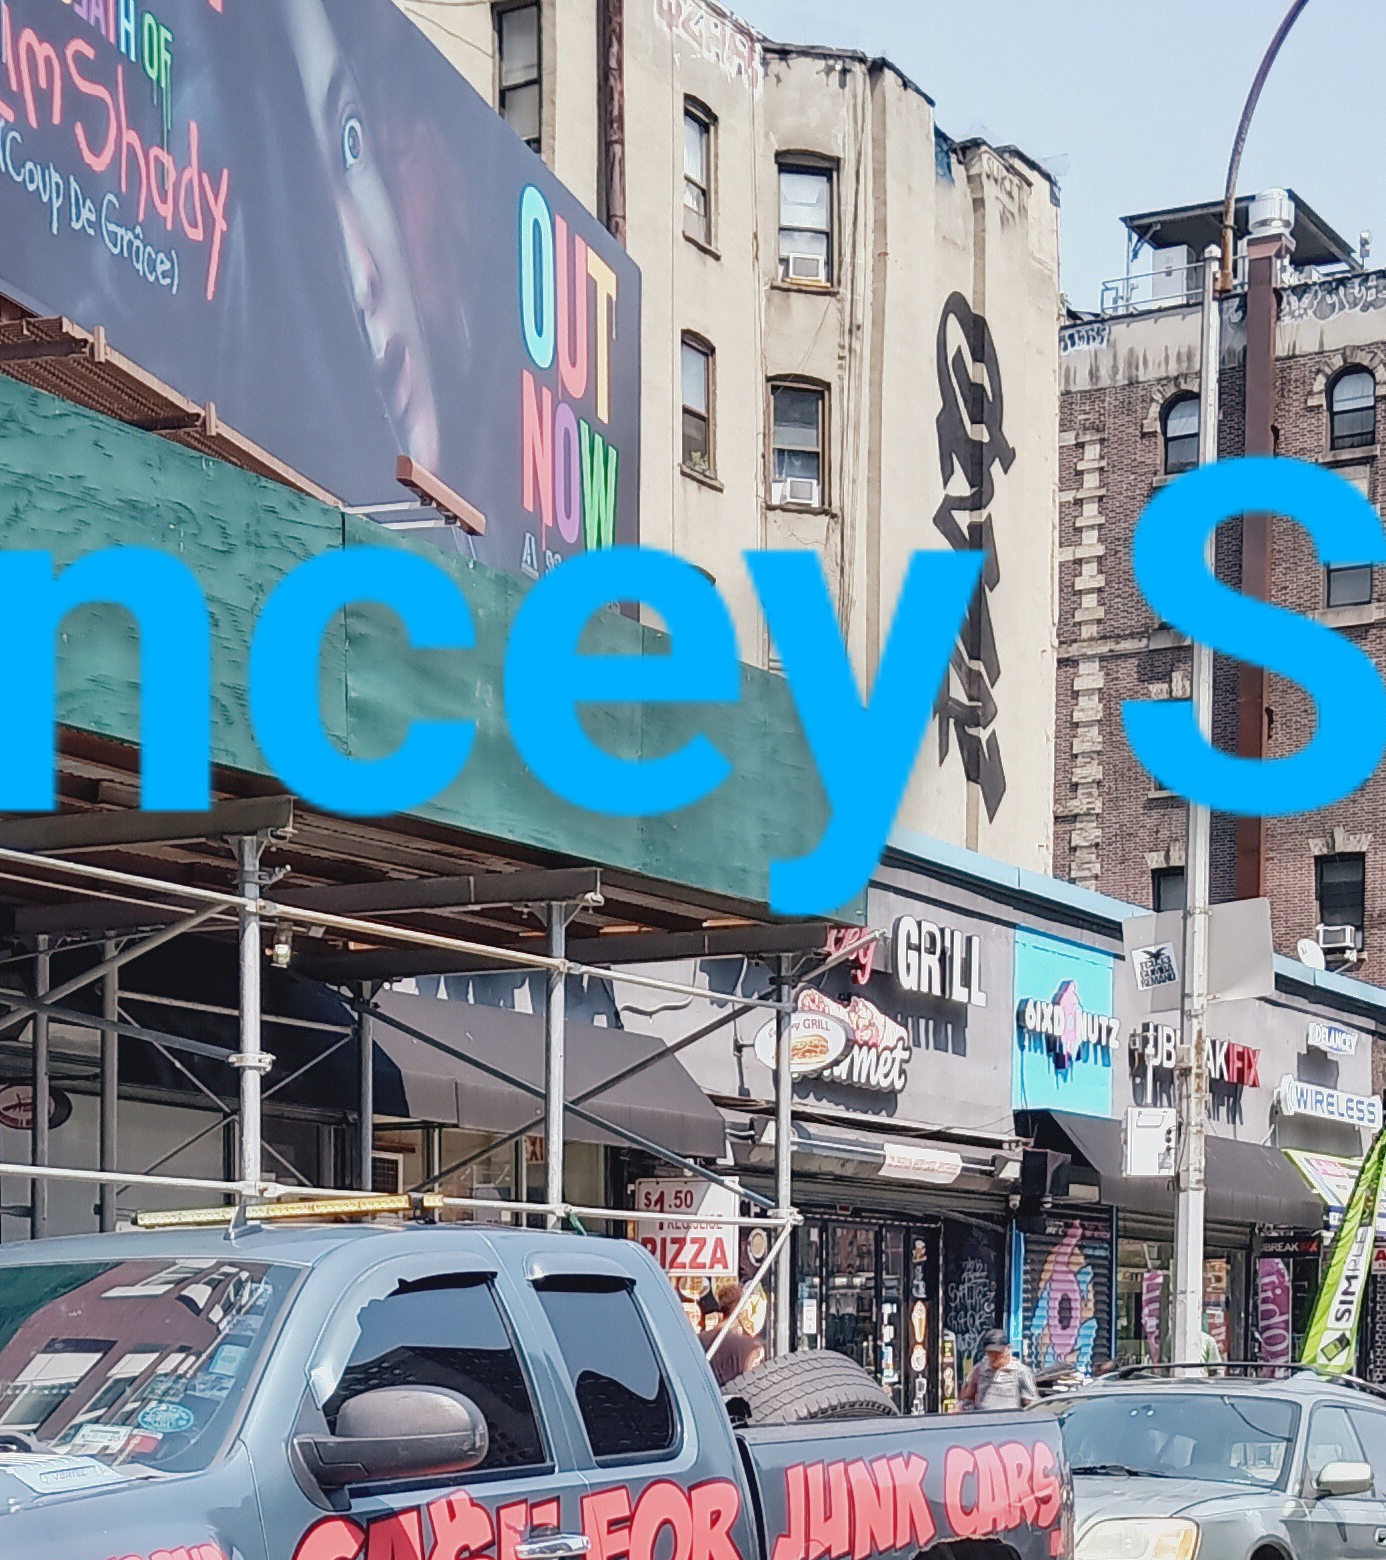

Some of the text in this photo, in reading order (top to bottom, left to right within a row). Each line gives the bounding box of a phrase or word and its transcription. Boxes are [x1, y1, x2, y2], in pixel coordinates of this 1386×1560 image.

[142, 10, 174, 90] OF
[65, 37, 229, 300] Shady
[70, 175, 96, 235] De
[519, 183, 617, 425] OUT
[522, 369, 618, 554] NOW
[894, 914, 987, 1008] GRILL
[803, 1018, 831, 1032] GRILL
[1295, 1084, 1376, 1124] WIRELESS
[640, 1236, 730, 1271] PIZZA
[944, 1439, 1063, 1537] CARS
